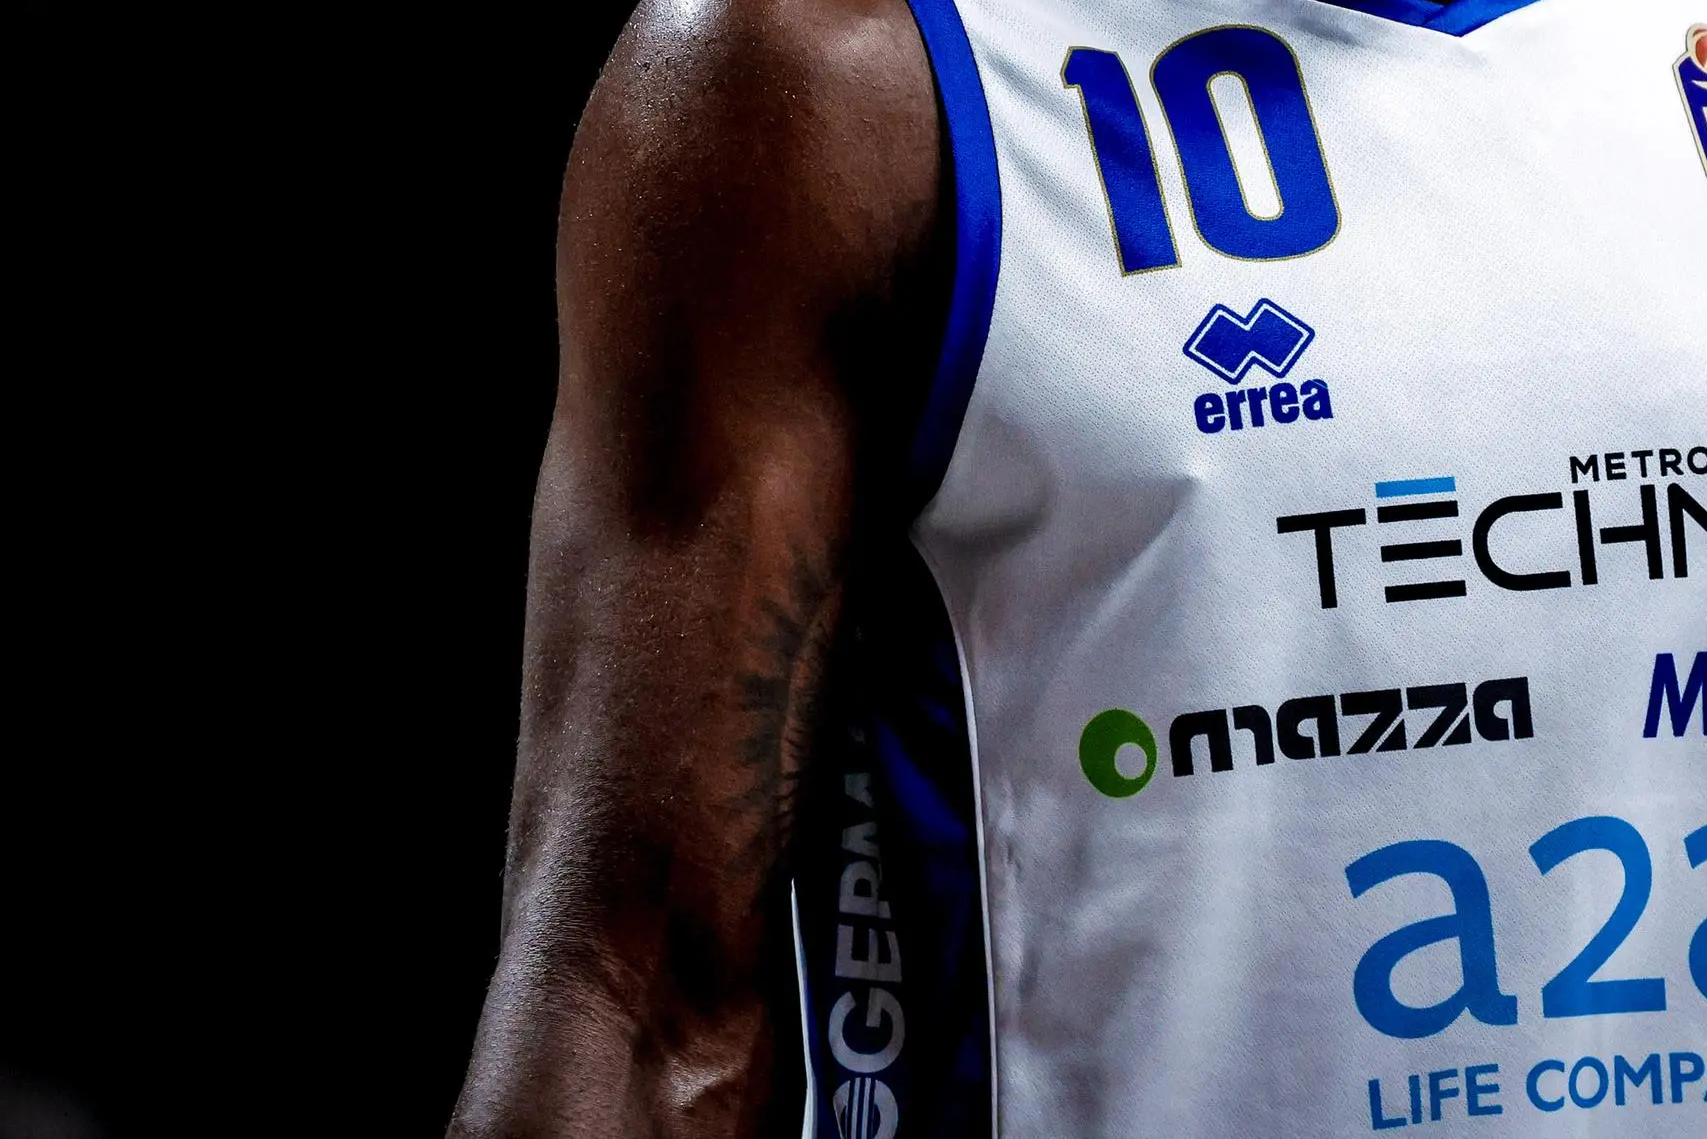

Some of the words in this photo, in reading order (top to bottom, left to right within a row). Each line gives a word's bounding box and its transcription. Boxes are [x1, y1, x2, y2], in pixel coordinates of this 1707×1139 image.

[1060, 23, 1342, 277] 10
[1193, 378, 1334, 434] errea
[1169, 676, 1535, 778] mazza
[1368, 1063, 1503, 1131] LIFE
